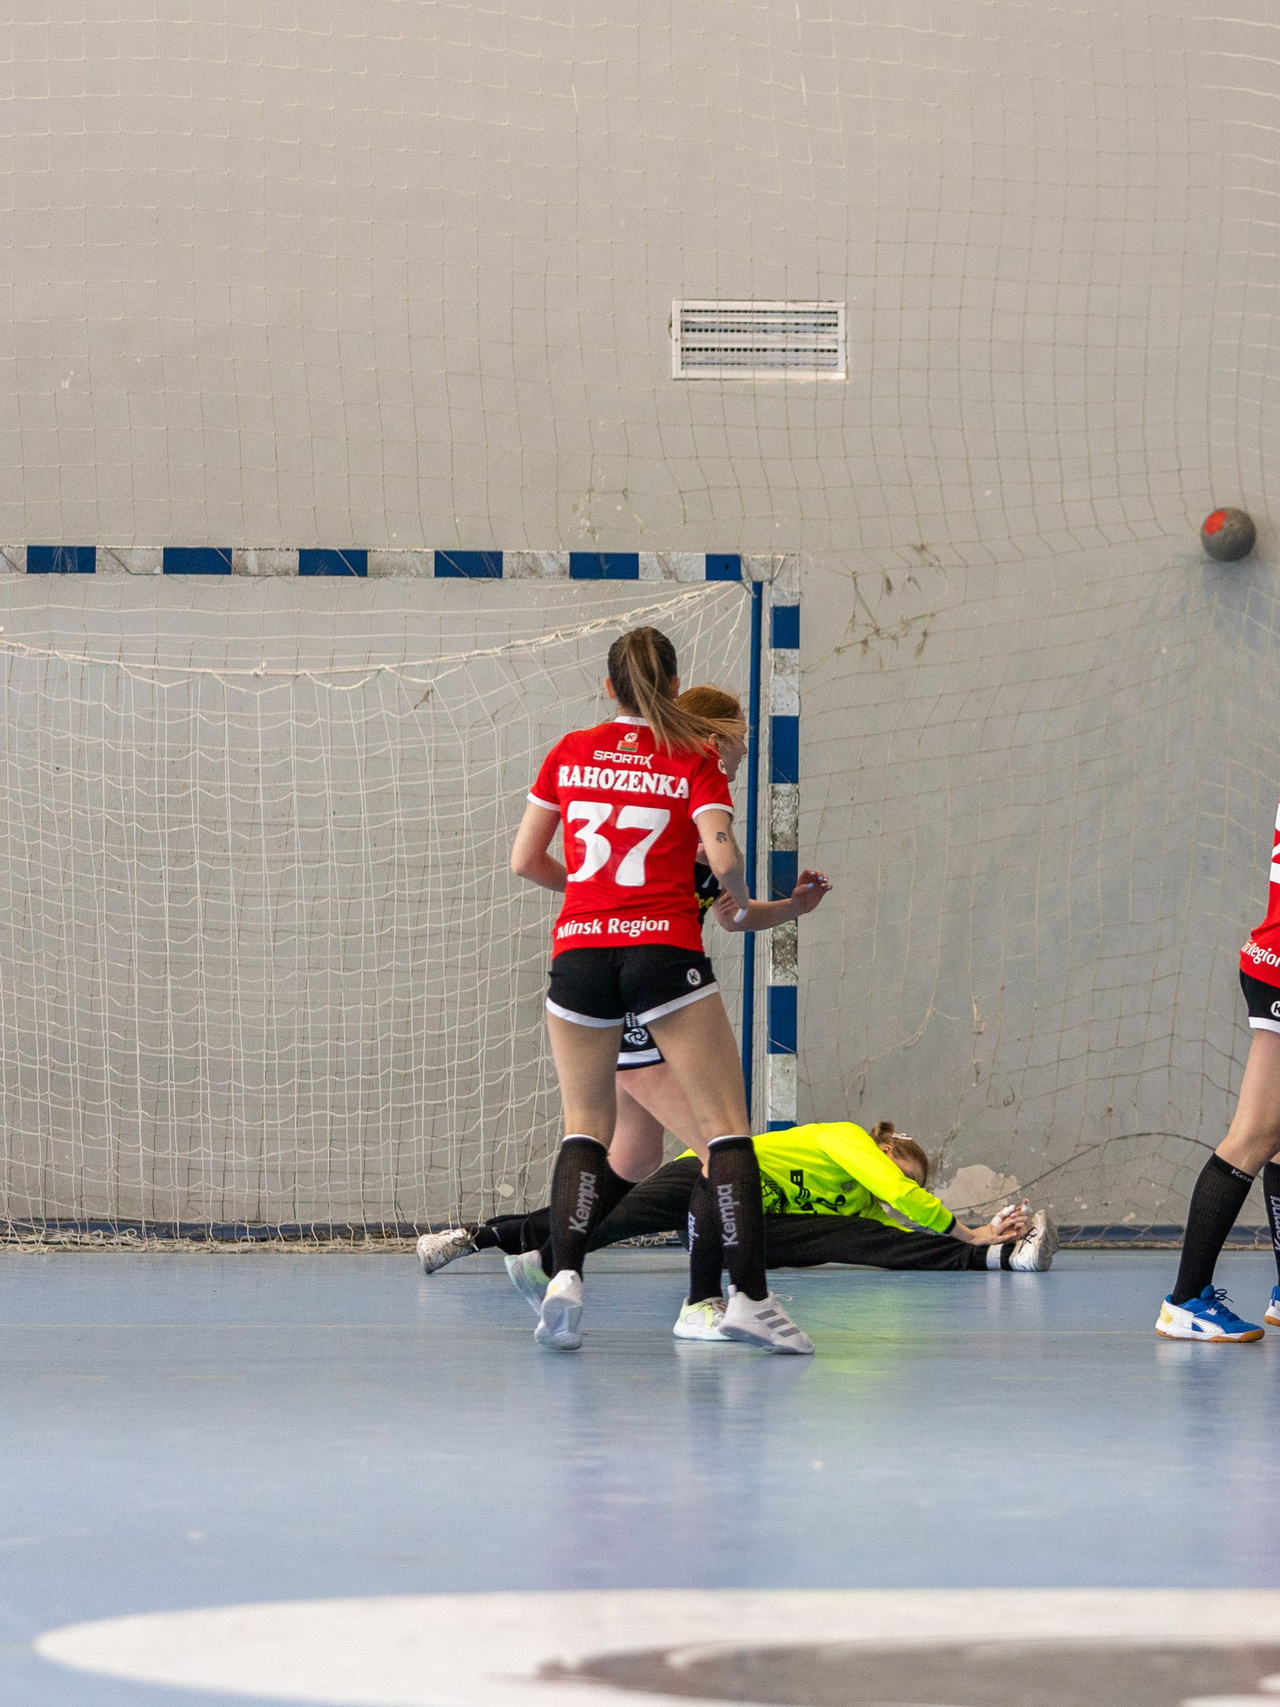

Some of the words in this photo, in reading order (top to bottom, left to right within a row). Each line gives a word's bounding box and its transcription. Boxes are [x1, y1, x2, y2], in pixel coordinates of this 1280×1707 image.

[558, 765, 689, 799] RAHOZENKA
[593, 750, 654, 769] SPORTIX
[567, 800, 671, 887] 37
[556, 919, 603, 940] Minsk
[607, 916, 670, 938] Region
[569, 1171, 599, 1234] Kempa
[717, 1184, 740, 1247] Kempa
